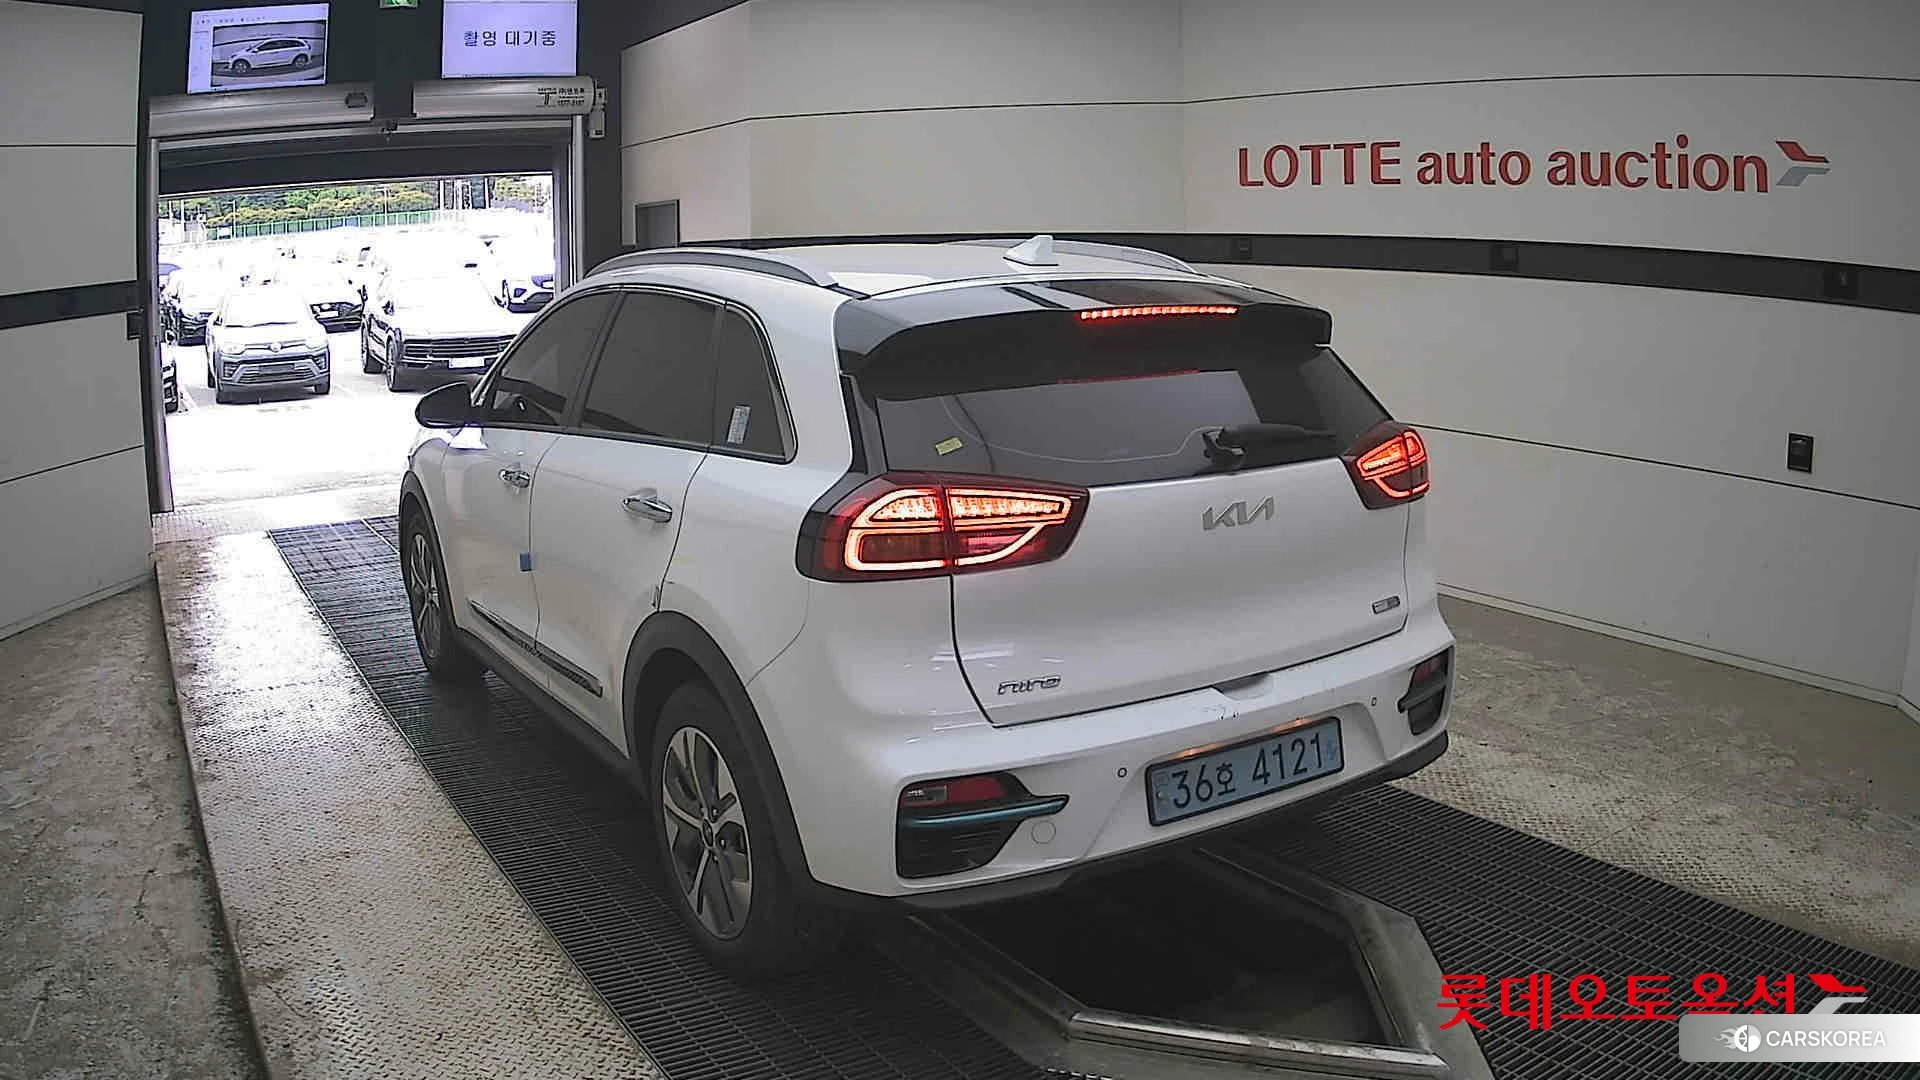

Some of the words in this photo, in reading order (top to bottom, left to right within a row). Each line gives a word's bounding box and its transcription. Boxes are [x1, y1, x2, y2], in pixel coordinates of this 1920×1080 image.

[505, 30, 557, 46] 대기중
[1239, 141, 1401, 188] LOTTE
[1416, 142, 1532, 187] auto
[1547, 134, 1770, 193] auction
[1202, 496, 1274, 530] KIA
[1171, 763, 1236, 808] 36호
[1252, 732, 1323, 785] 4121
